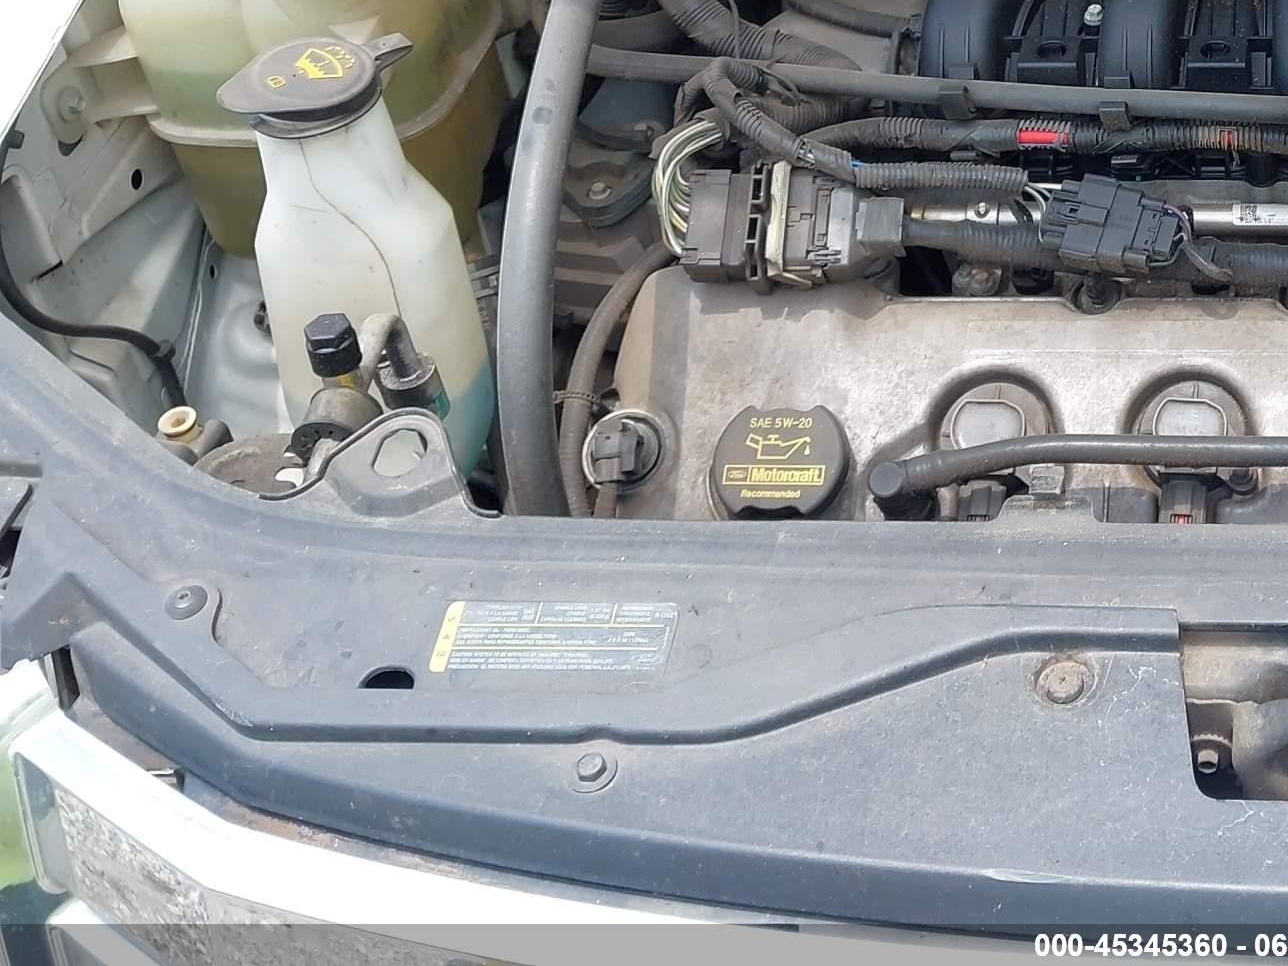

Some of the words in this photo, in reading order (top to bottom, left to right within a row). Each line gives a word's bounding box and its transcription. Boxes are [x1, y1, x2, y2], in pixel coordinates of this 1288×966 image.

[749, 417, 772, 428] SAE
[775, 417, 812, 428] 5W-20
[751, 467, 822, 482] Motorcraft
[740, 489, 801, 498] Recommended
